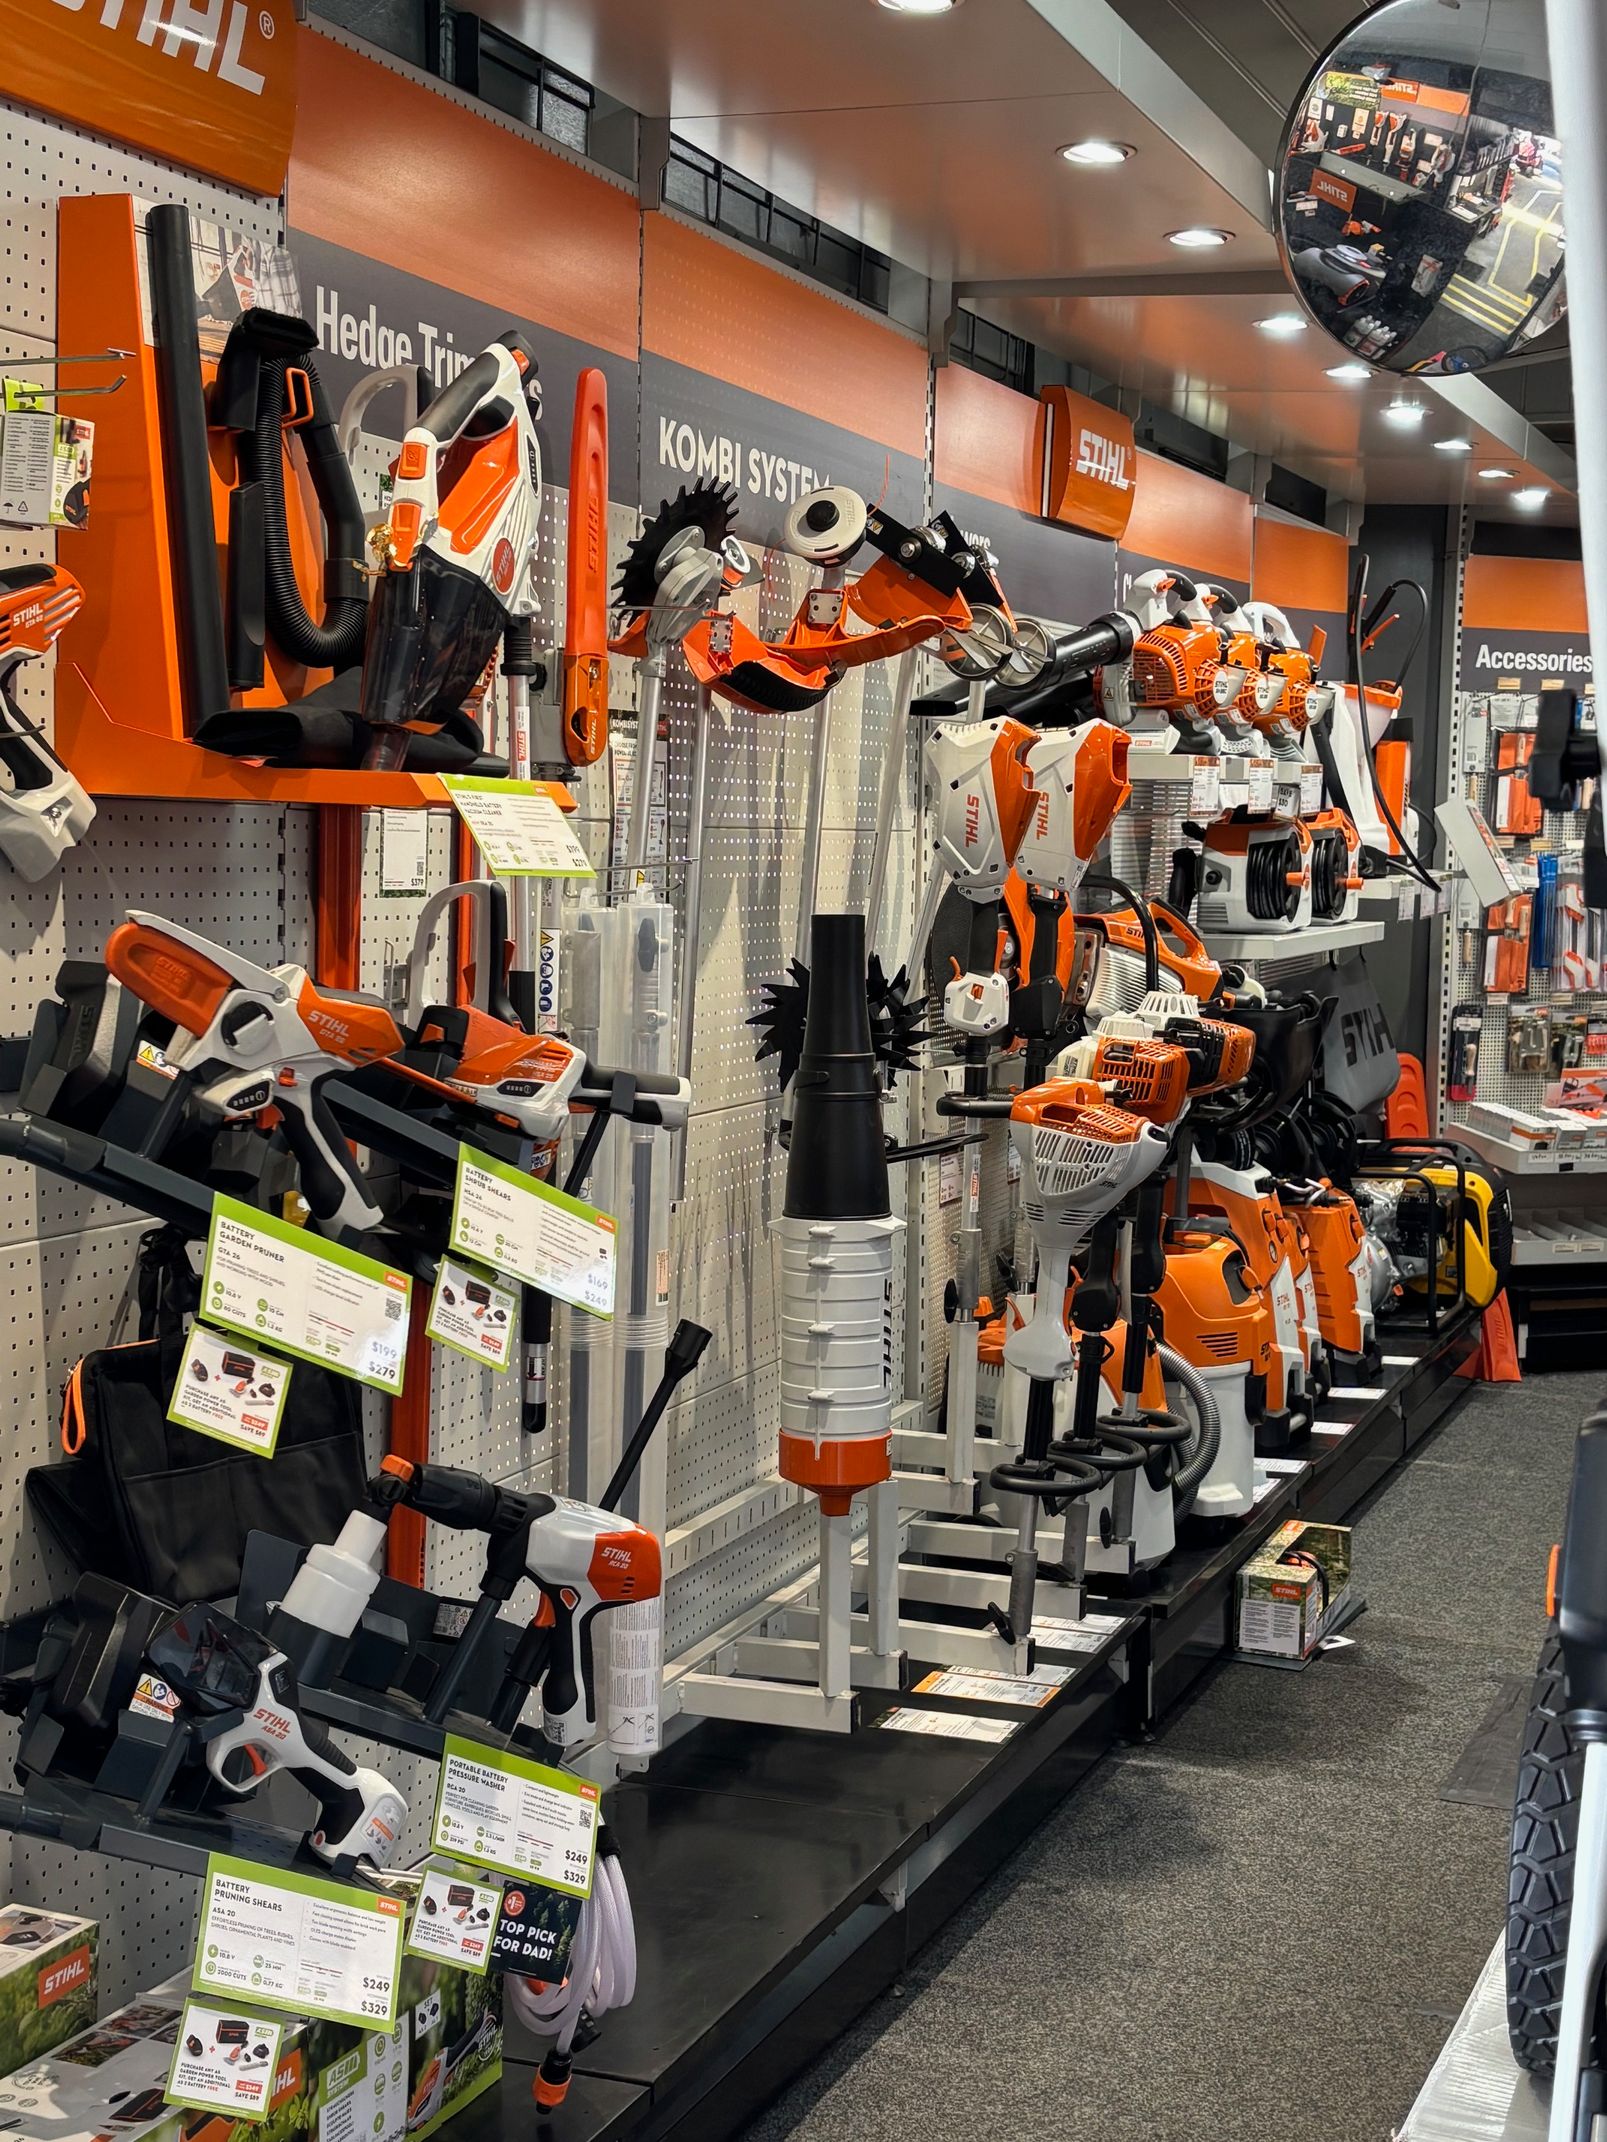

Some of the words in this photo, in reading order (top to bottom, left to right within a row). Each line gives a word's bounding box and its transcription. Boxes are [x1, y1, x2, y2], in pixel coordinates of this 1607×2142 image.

[316, 285, 413, 369] Hedge
[659, 416, 741, 488] KOMBI
[1076, 429, 1130, 491] STIHL
[13, 603, 44, 627] STIHL
[1475, 644, 1594, 674] Accessories
[589, 718, 597, 755] STIHL
[518, 731, 526, 761] STIHL
[965, 794, 980, 848] STIHL
[1036, 791, 1050, 841] STIHL
[308, 1010, 350, 1037] STIHL
[319, 1028, 334, 1039] GTA
[465, 1166, 493, 1185] BATTERY
[464, 1173, 485, 1189] SHRUB
[486, 1185, 511, 1202] SHEARS
[971, 1172, 979, 1197] STIHL
[220, 1221, 255, 1241] BATTERY
[217, 1246, 231, 1257] GTA
[231, 1251, 240, 1260] 26
[219, 1230, 252, 1250] GARDEN
[253, 1244, 284, 1263] PRUNER
[386, 1275, 407, 1289] STIHL
[587, 1272, 608, 1291] $169
[372, 1341, 396, 1360] $199
[368, 1360, 396, 1381] $279
[191, 1403, 212, 1415] BATTERY
[240, 1423, 254, 1433] SAVE
[601, 1547, 632, 1563] STIHL
[608, 1560, 620, 1568] RCA
[1275, 1587, 1298, 1595] STIHL
[253, 1708, 291, 1733] STIHL
[261, 1725, 275, 1736] ASA
[274, 1731, 287, 1740] 20
[448, 1767, 479, 1783] PRESSURE
[480, 1778, 505, 1792] WASHER
[449, 1758, 481, 1775] PORTABLE
[481, 1769, 508, 1784] BATTERY
[446, 1782, 458, 1791] RCA
[581, 1787, 597, 1797] STIHL
[564, 1849, 588, 1865] $249
[563, 1869, 586, 1885] $329
[215, 1878, 250, 1894] BATTERY
[214, 1888, 251, 1904] PRUNING
[252, 1898, 282, 1912] SHEARS
[380, 1902, 399, 1913] STIHL
[212, 1906, 225, 1915] ASA
[226, 1909, 236, 1917] 20
[500, 1919, 525, 1935] TOP
[527, 1926, 557, 1944] PICK
[218, 1951, 230, 1959] 10.8
[460, 1947, 472, 1955] SAVE
[494, 1936, 520, 1953] FOR
[522, 1942, 553, 1961] DAD!
[43, 1959, 84, 1995] STIHL
[232, 1971, 246, 1981] CUTS
[262, 1979, 273, 1987] 0.77
[362, 1976, 390, 1993] $249
[360, 2000, 388, 2017] $329
[179, 2068, 198, 2076] GARDEN
[197, 2071, 214, 2079] POWER
[180, 2062, 204, 2071] PURCHASE
[187, 2081, 206, 2089] BATTERY
[203, 2078, 231, 2088] ADDITIONAL
[245, 2083, 260, 2091] $349
[234, 2091, 249, 2099] SAVE
